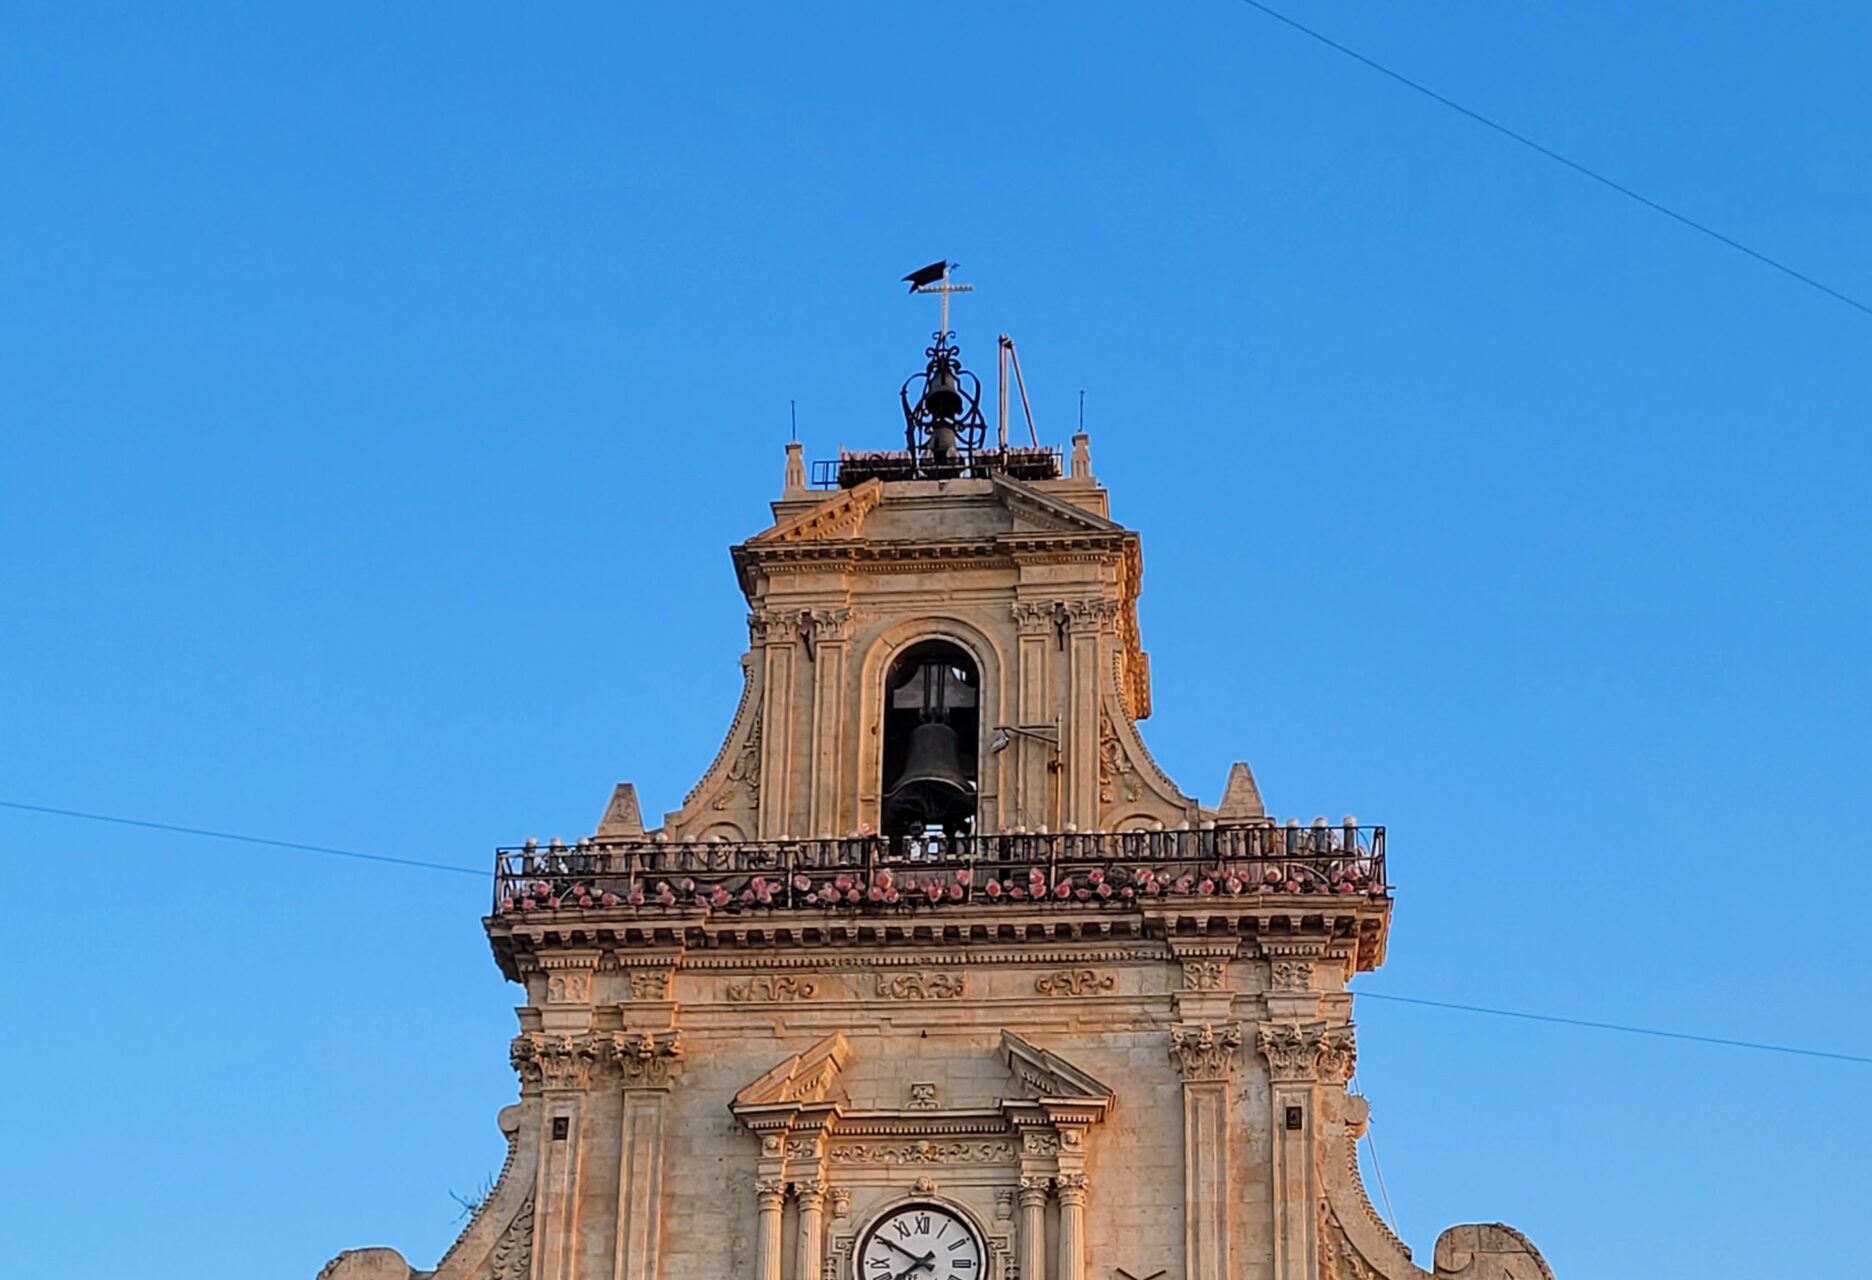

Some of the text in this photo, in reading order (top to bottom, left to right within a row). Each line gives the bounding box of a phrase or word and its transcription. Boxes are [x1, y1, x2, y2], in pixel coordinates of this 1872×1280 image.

[893, 1221, 911, 1240] XI
[915, 1216, 930, 1234] XII
[937, 1223, 948, 1239] I
[948, 1239, 966, 1251] II
[870, 1258, 890, 1268] IX
[952, 1260, 971, 1268] III
